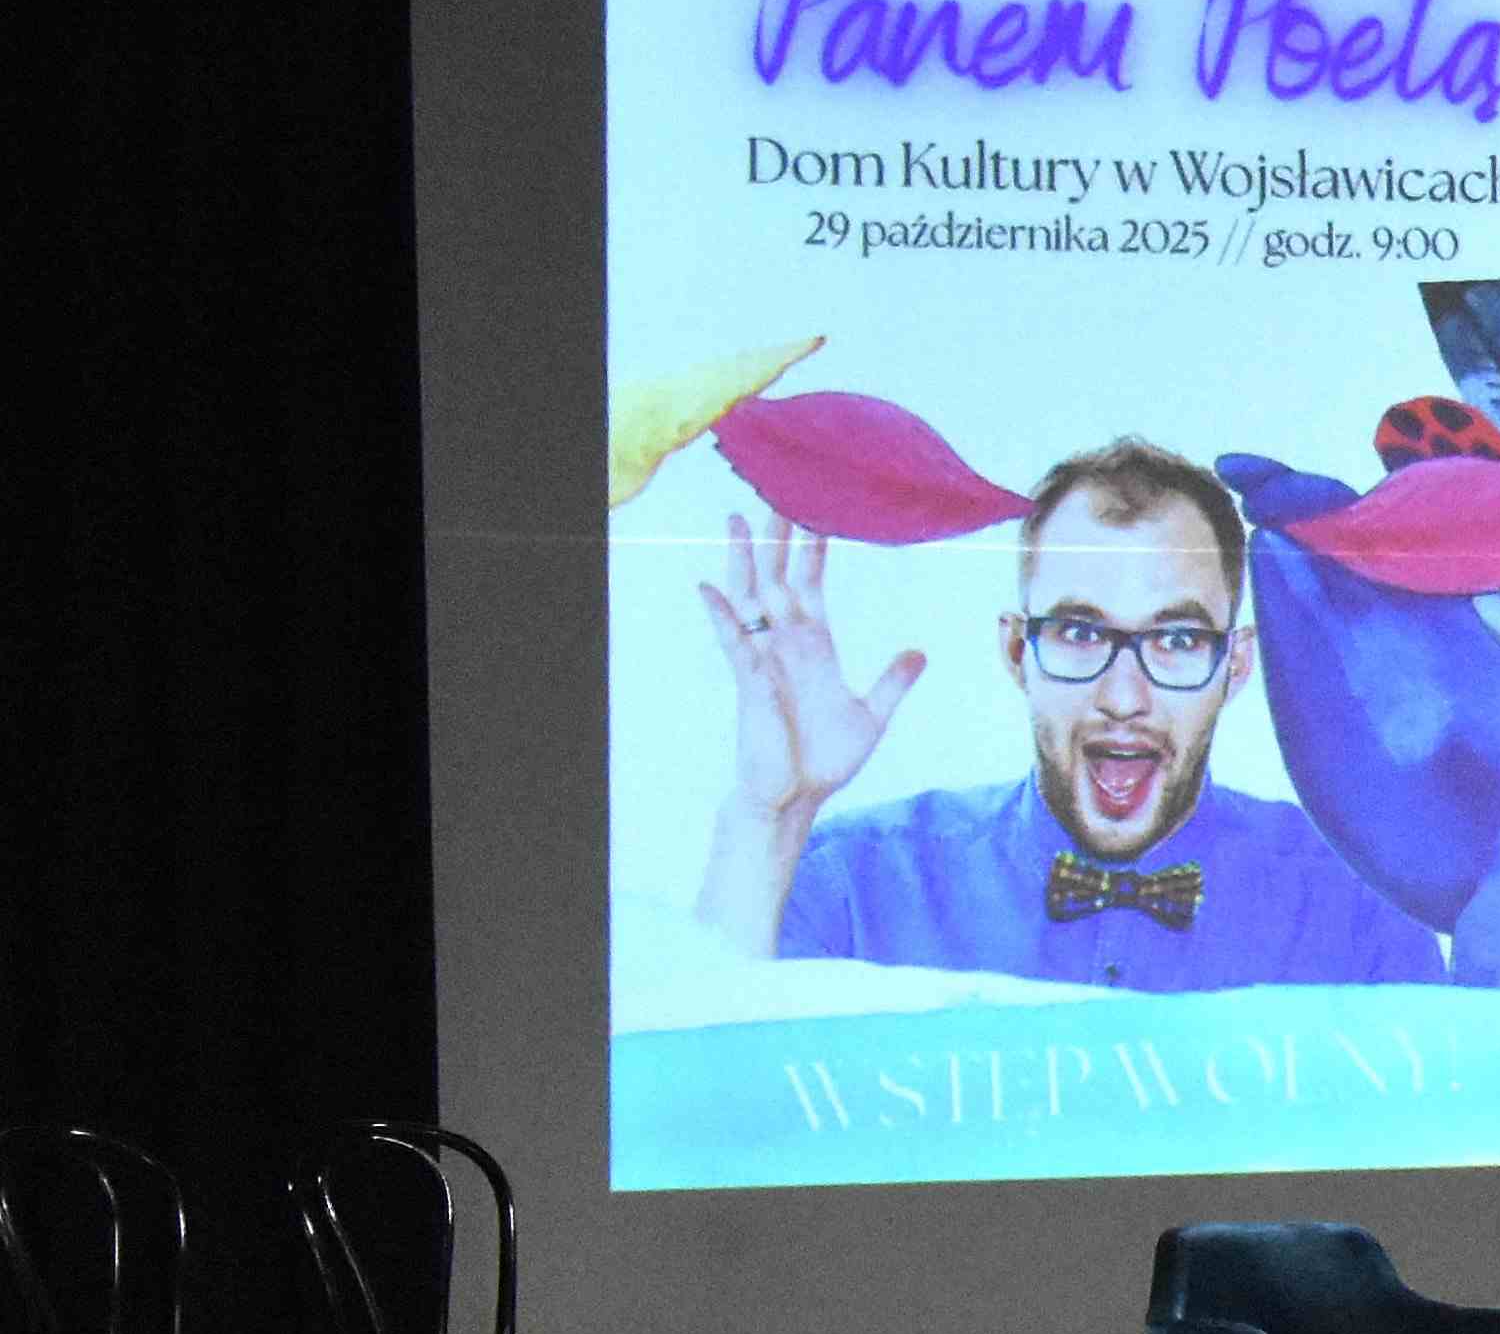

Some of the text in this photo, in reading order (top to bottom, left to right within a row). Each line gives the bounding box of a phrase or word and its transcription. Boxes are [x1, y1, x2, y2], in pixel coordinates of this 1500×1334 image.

[747, 135, 885, 188] Dom
[901, 137, 1101, 205] Kultury
[1113, 161, 1158, 195] w
[804, 210, 851, 249] 29
[861, 210, 1109, 259] października
[1118, 219, 1211, 257] 2025
[1262, 220, 1361, 269] godz.
[1371, 226, 1461, 262] 9:00
[1114, 1023, 1465, 1113] WOLNY!
